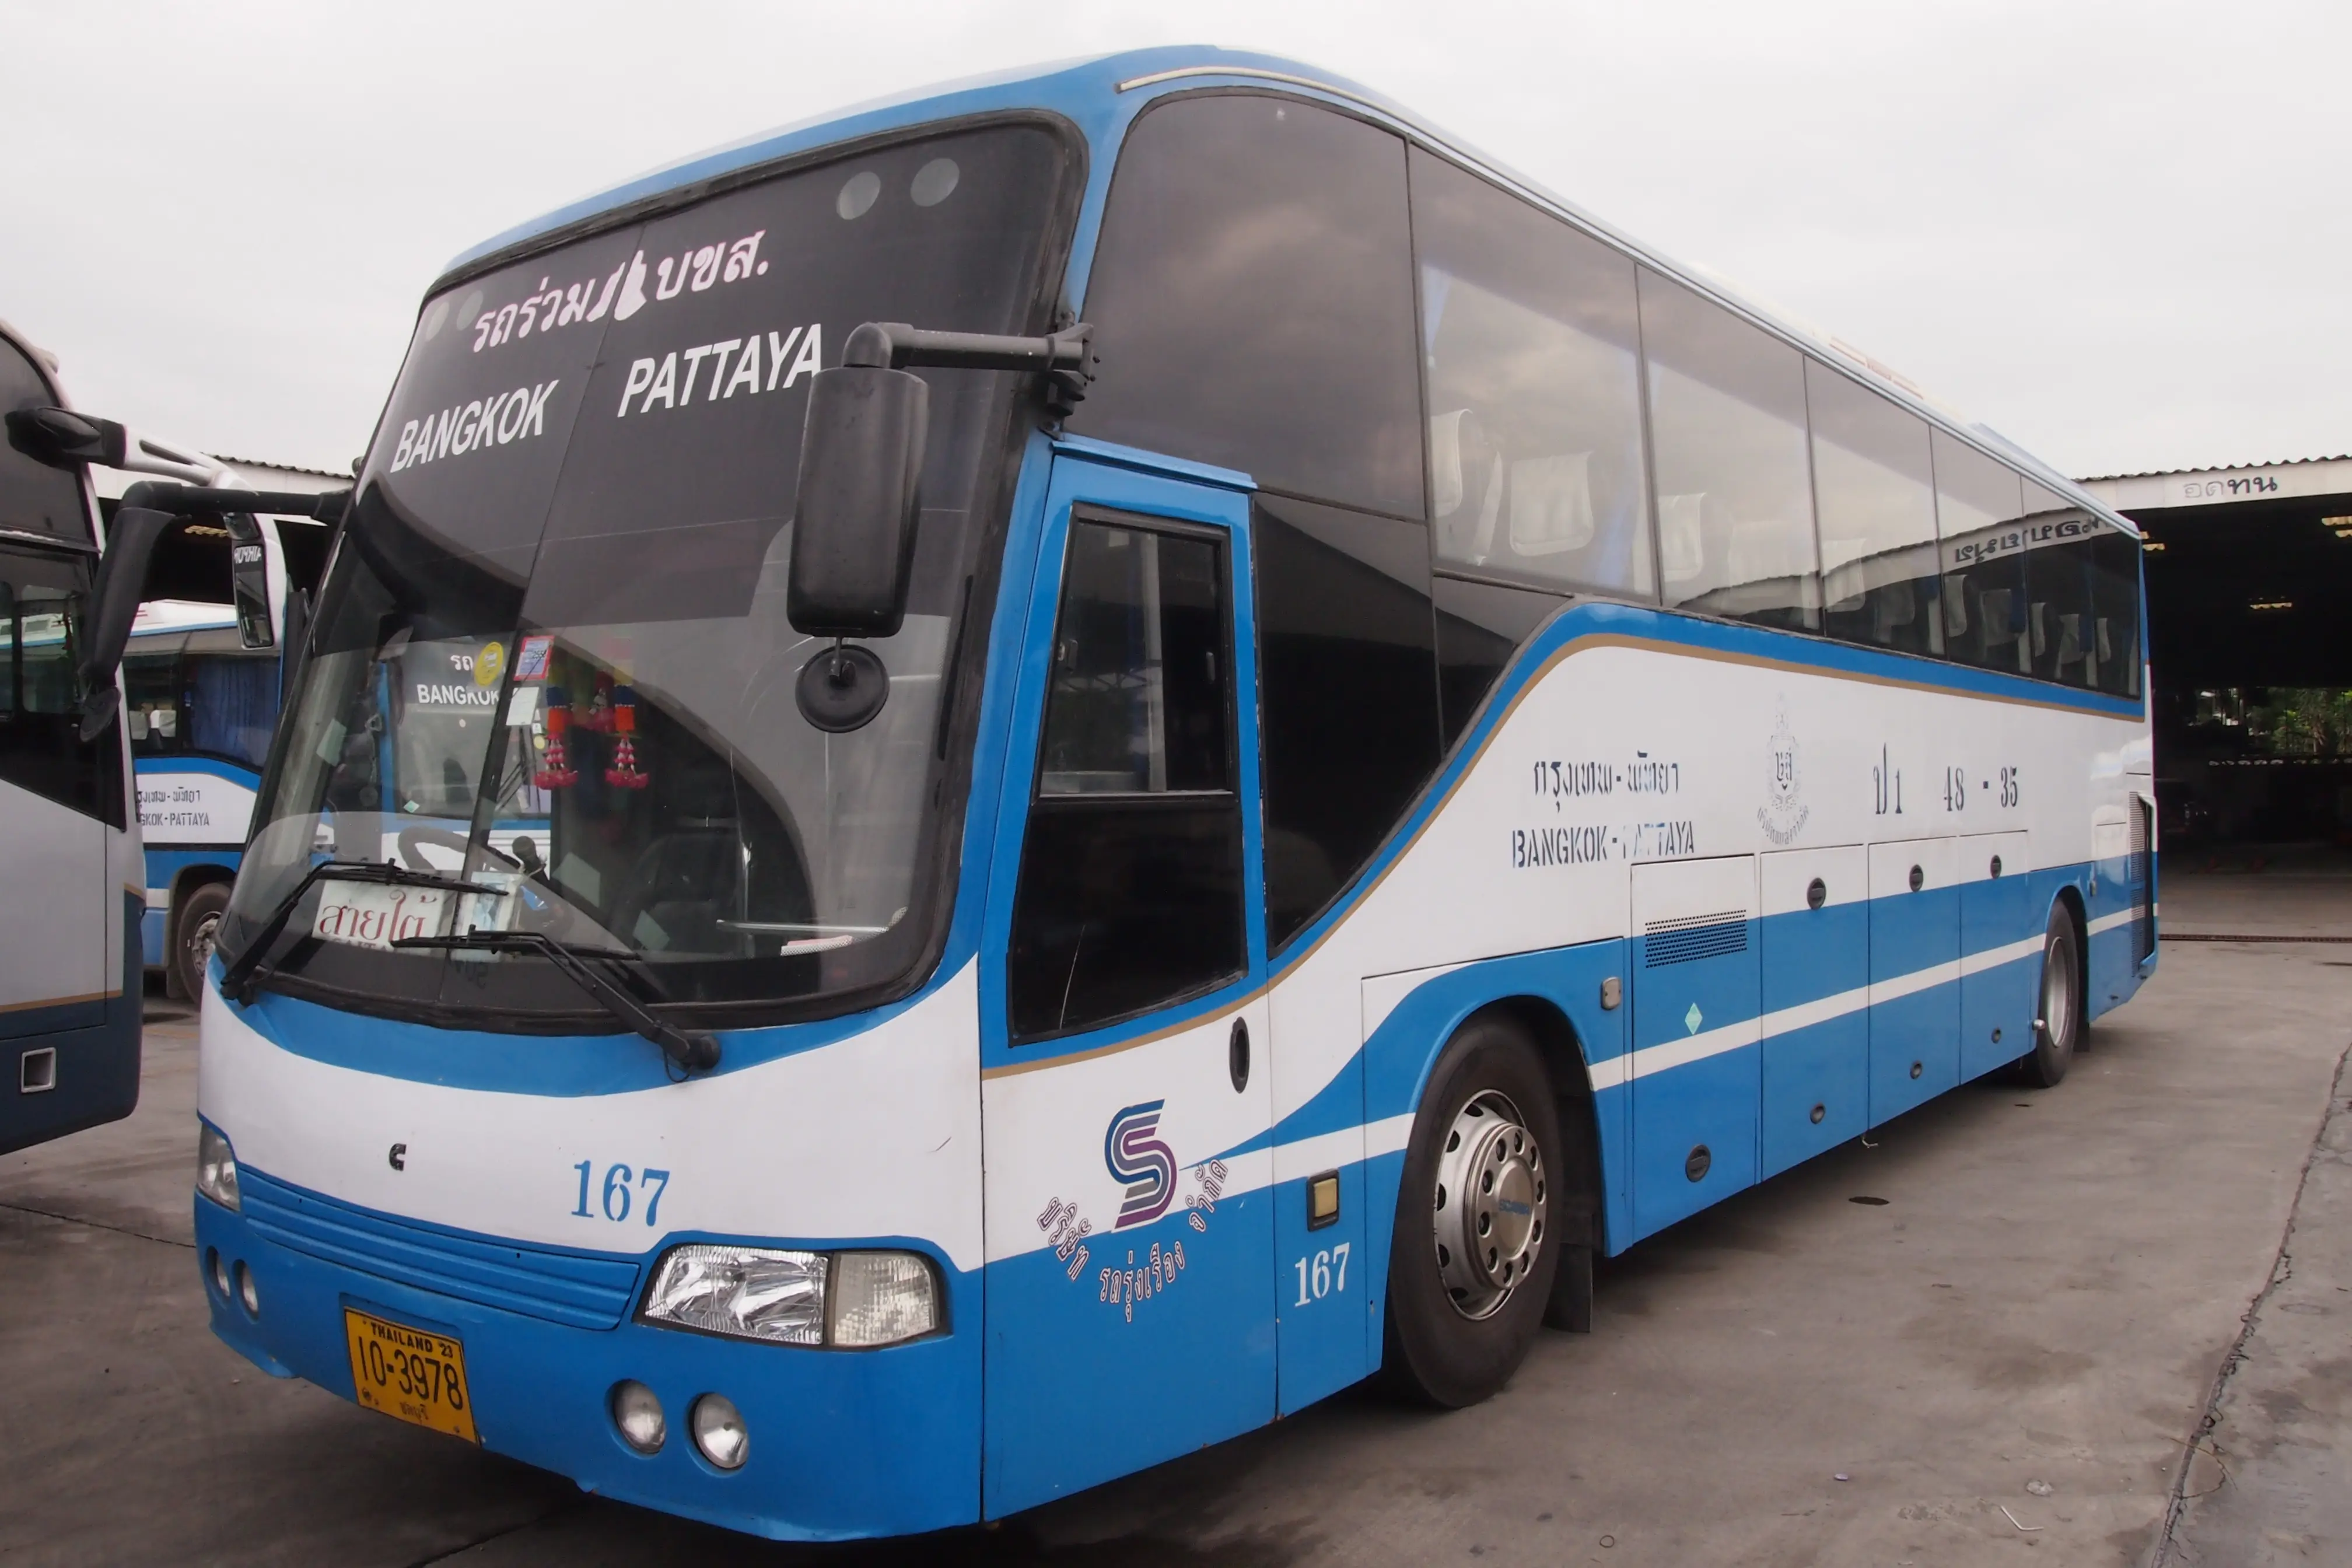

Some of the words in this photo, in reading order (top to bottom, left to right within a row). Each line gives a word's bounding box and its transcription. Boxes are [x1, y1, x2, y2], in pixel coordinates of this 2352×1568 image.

[390, 379, 560, 474] BANGKOK
[617, 323, 822, 418] PATTAYA
[571, 1160, 670, 1227] 167
[1294, 1241, 1350, 1308] 167
[370, 1322, 433, 1353] THAILAND
[358, 1336, 463, 1410] 10-3978
